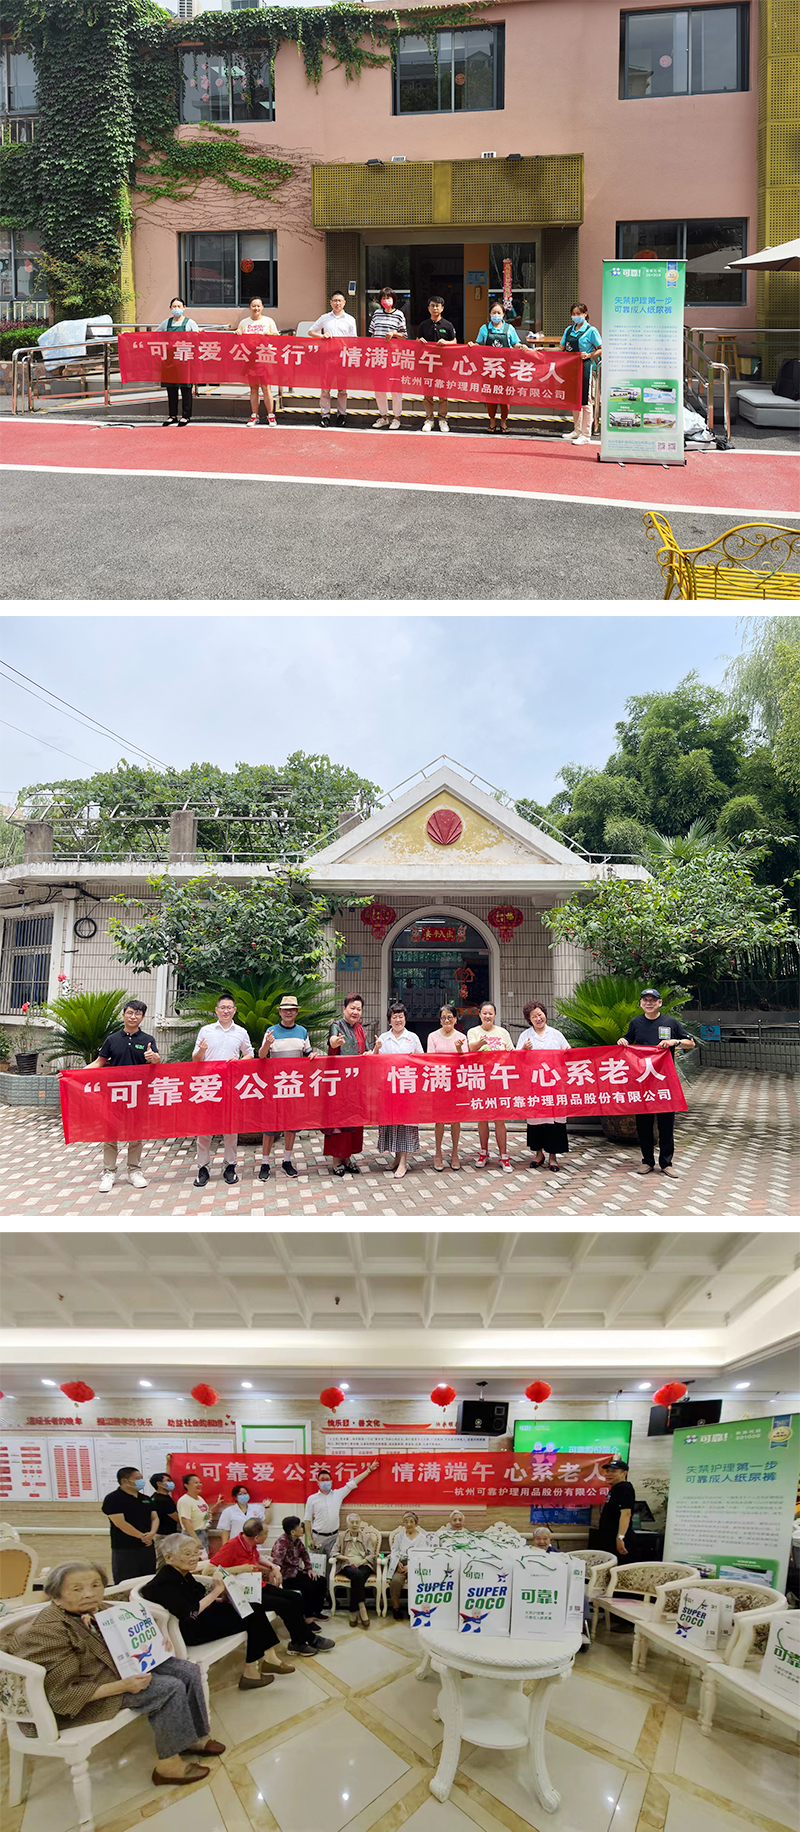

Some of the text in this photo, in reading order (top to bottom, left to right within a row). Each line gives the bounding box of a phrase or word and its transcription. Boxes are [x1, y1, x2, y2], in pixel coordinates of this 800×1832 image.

[614, 296, 673, 305] 失禁护理第一步
[614, 305, 673, 314] 可靠成人纸尿裤
[340, 346, 443, 373] 情满端午
[452, 356, 565, 384] 心系老人
[387, 1062, 520, 1094] 情满端午
[531, 1057, 666, 1088] 心系老人
[392, 1462, 495, 1483] 情满端午
[504, 1462, 606, 1482] 心系老人
[686, 1460, 778, 1475] 失禁护理第一步
[685, 1472, 777, 1484] 可靠成人纸尿裤
[416, 1581, 454, 1593] SUPER
[467, 1586, 508, 1598] SUPER
[414, 1592, 453, 1605] COCO
[464, 1597, 506, 1610] COCO
[521, 1589, 558, 1605] 可靠!
[679, 1613, 704, 1627] COCO
[681, 1606, 707, 1620] SUPER
[128, 1617, 153, 1637] SUPER
[131, 1626, 157, 1650] COCO
